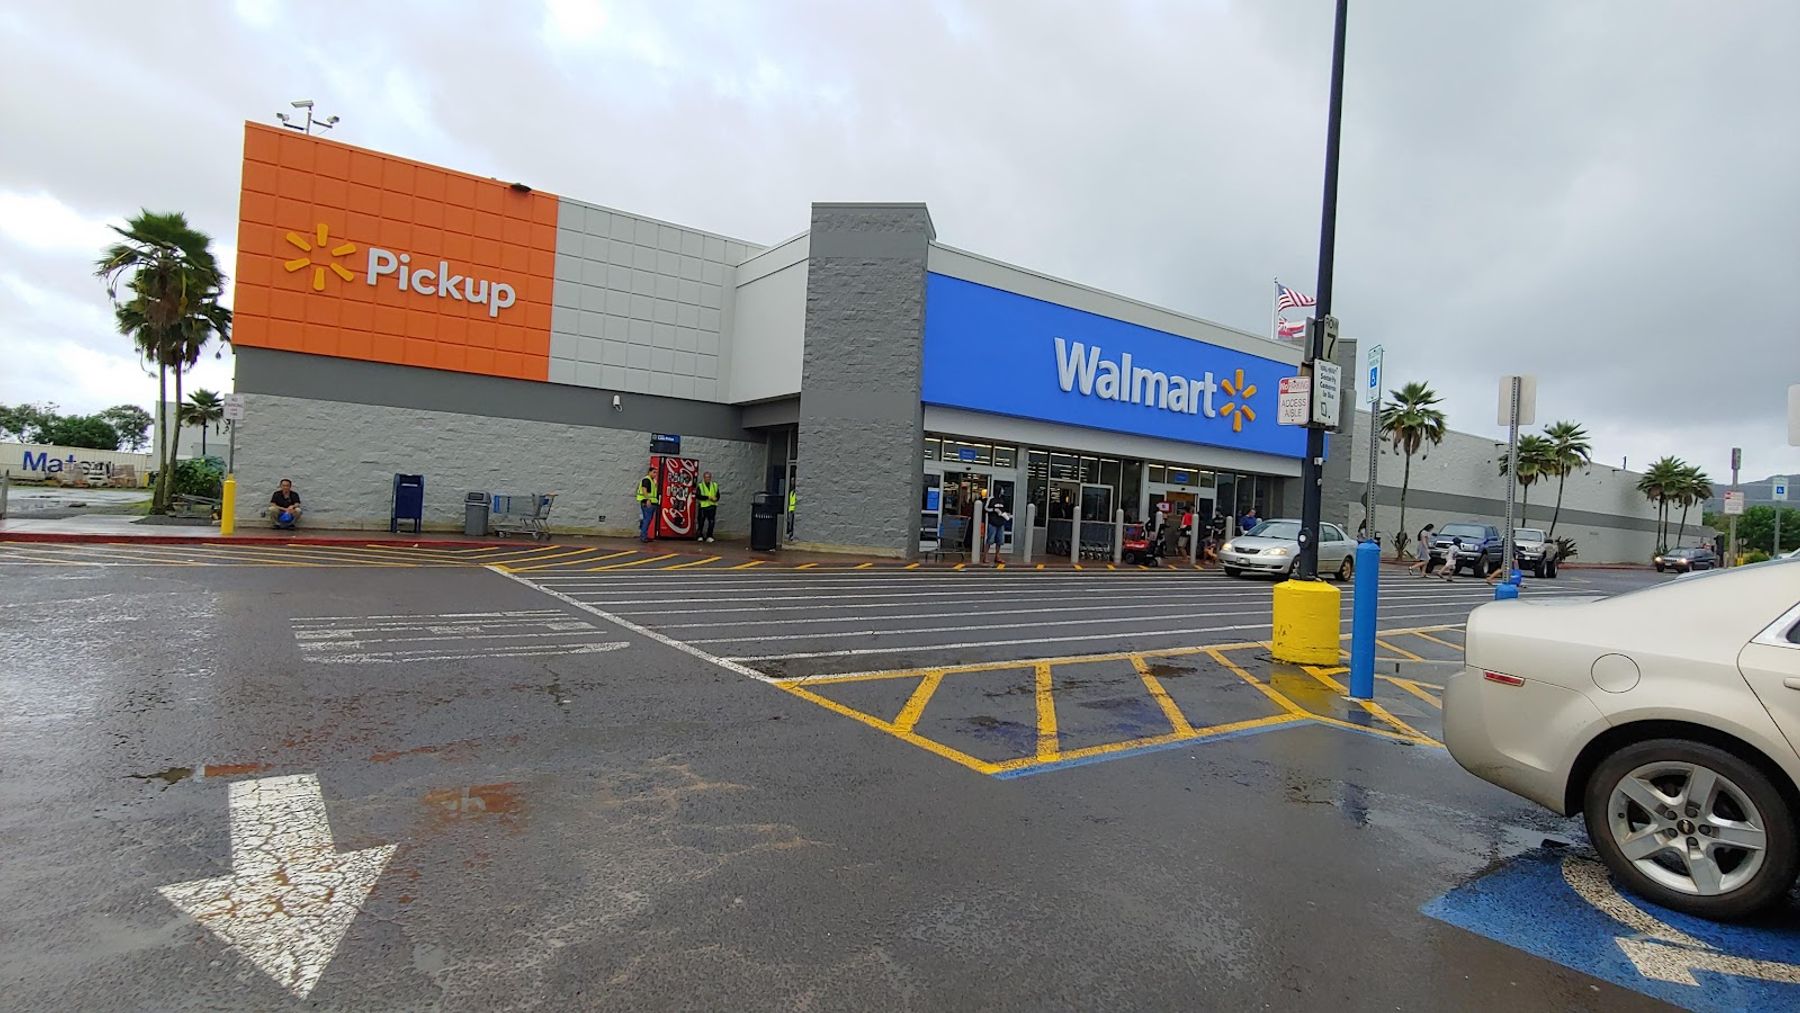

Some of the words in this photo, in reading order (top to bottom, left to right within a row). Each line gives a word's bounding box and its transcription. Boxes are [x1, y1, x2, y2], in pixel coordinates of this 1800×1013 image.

[366, 247, 516, 318] Pickup
[1327, 332, 1337, 359] 7
[1054, 337, 1217, 418] Walmart
[1281, 398, 1307, 408] ACCESS
[1284, 408, 1302, 418] AISLE
